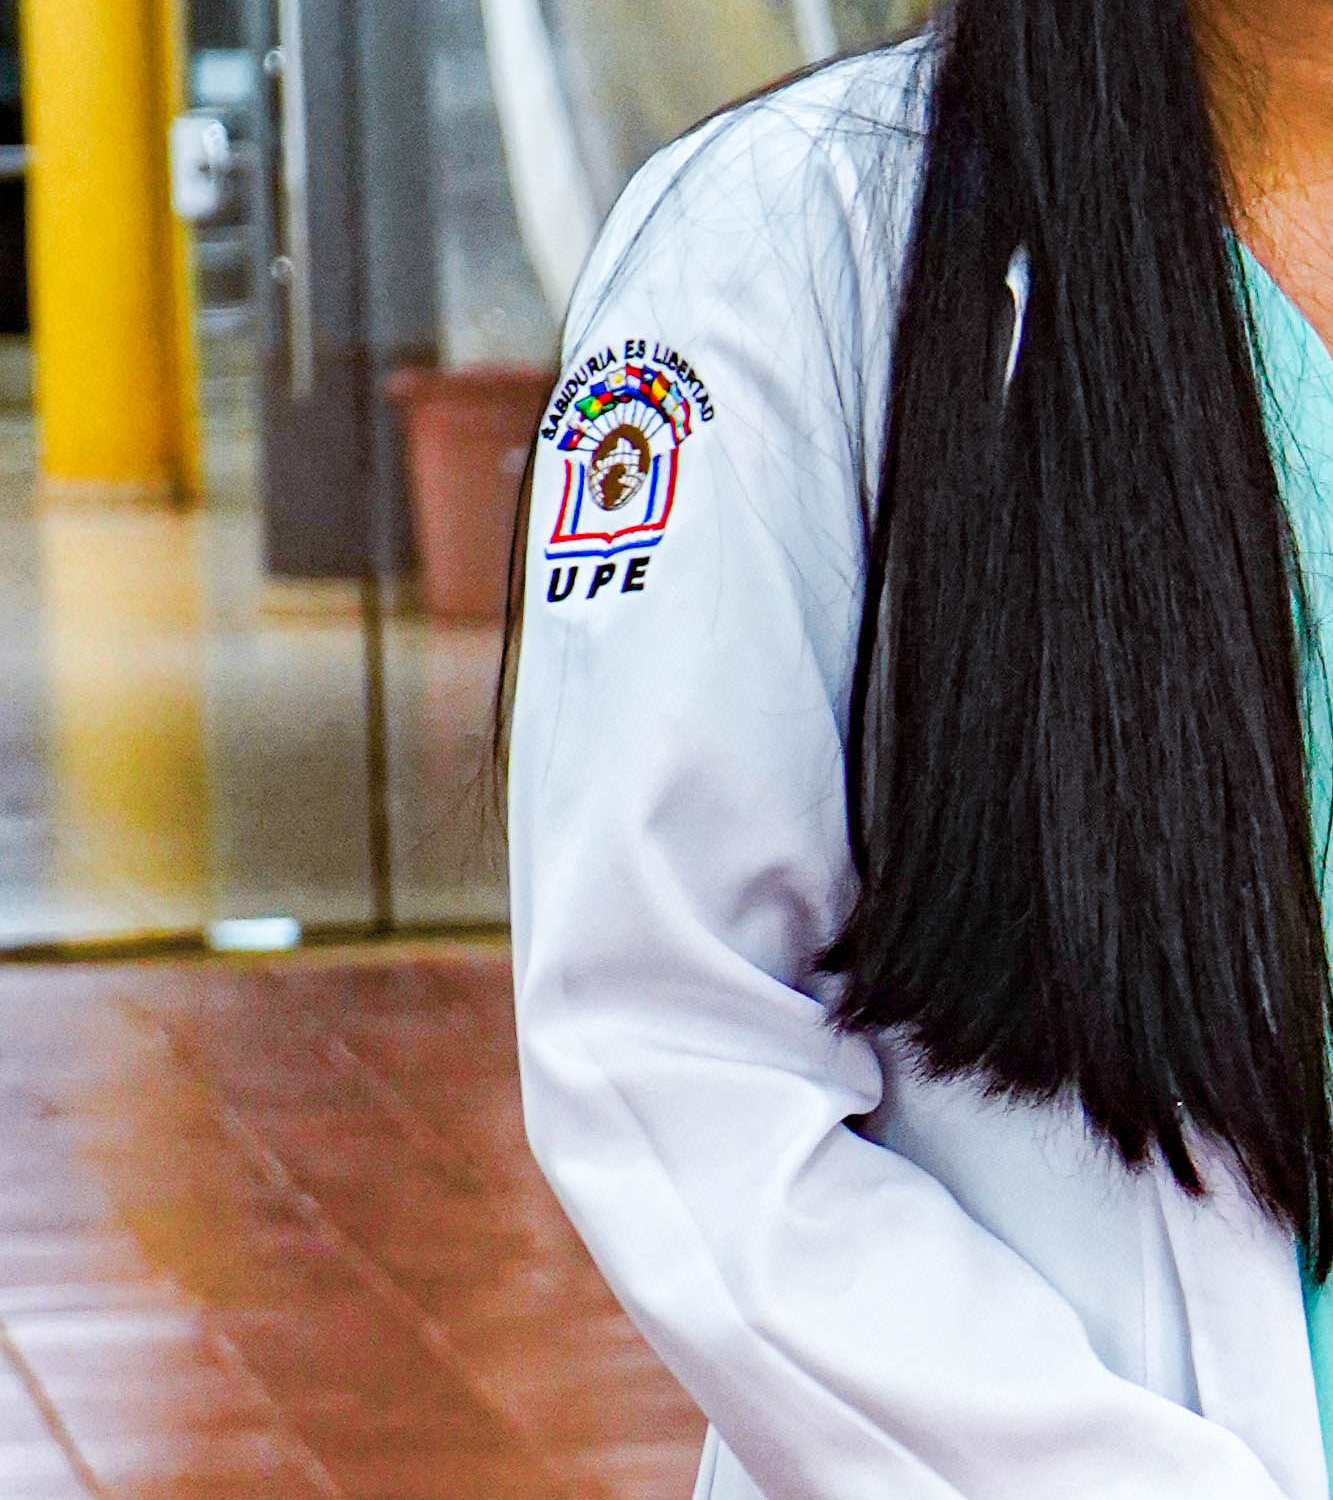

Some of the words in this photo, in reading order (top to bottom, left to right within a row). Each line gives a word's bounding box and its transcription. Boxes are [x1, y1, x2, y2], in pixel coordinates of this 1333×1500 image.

[541, 346, 617, 440] SABIDURIA
[624, 339, 646, 360] ES
[653, 341, 714, 422] LIBERTAD
[546, 556, 650, 603] UPE
